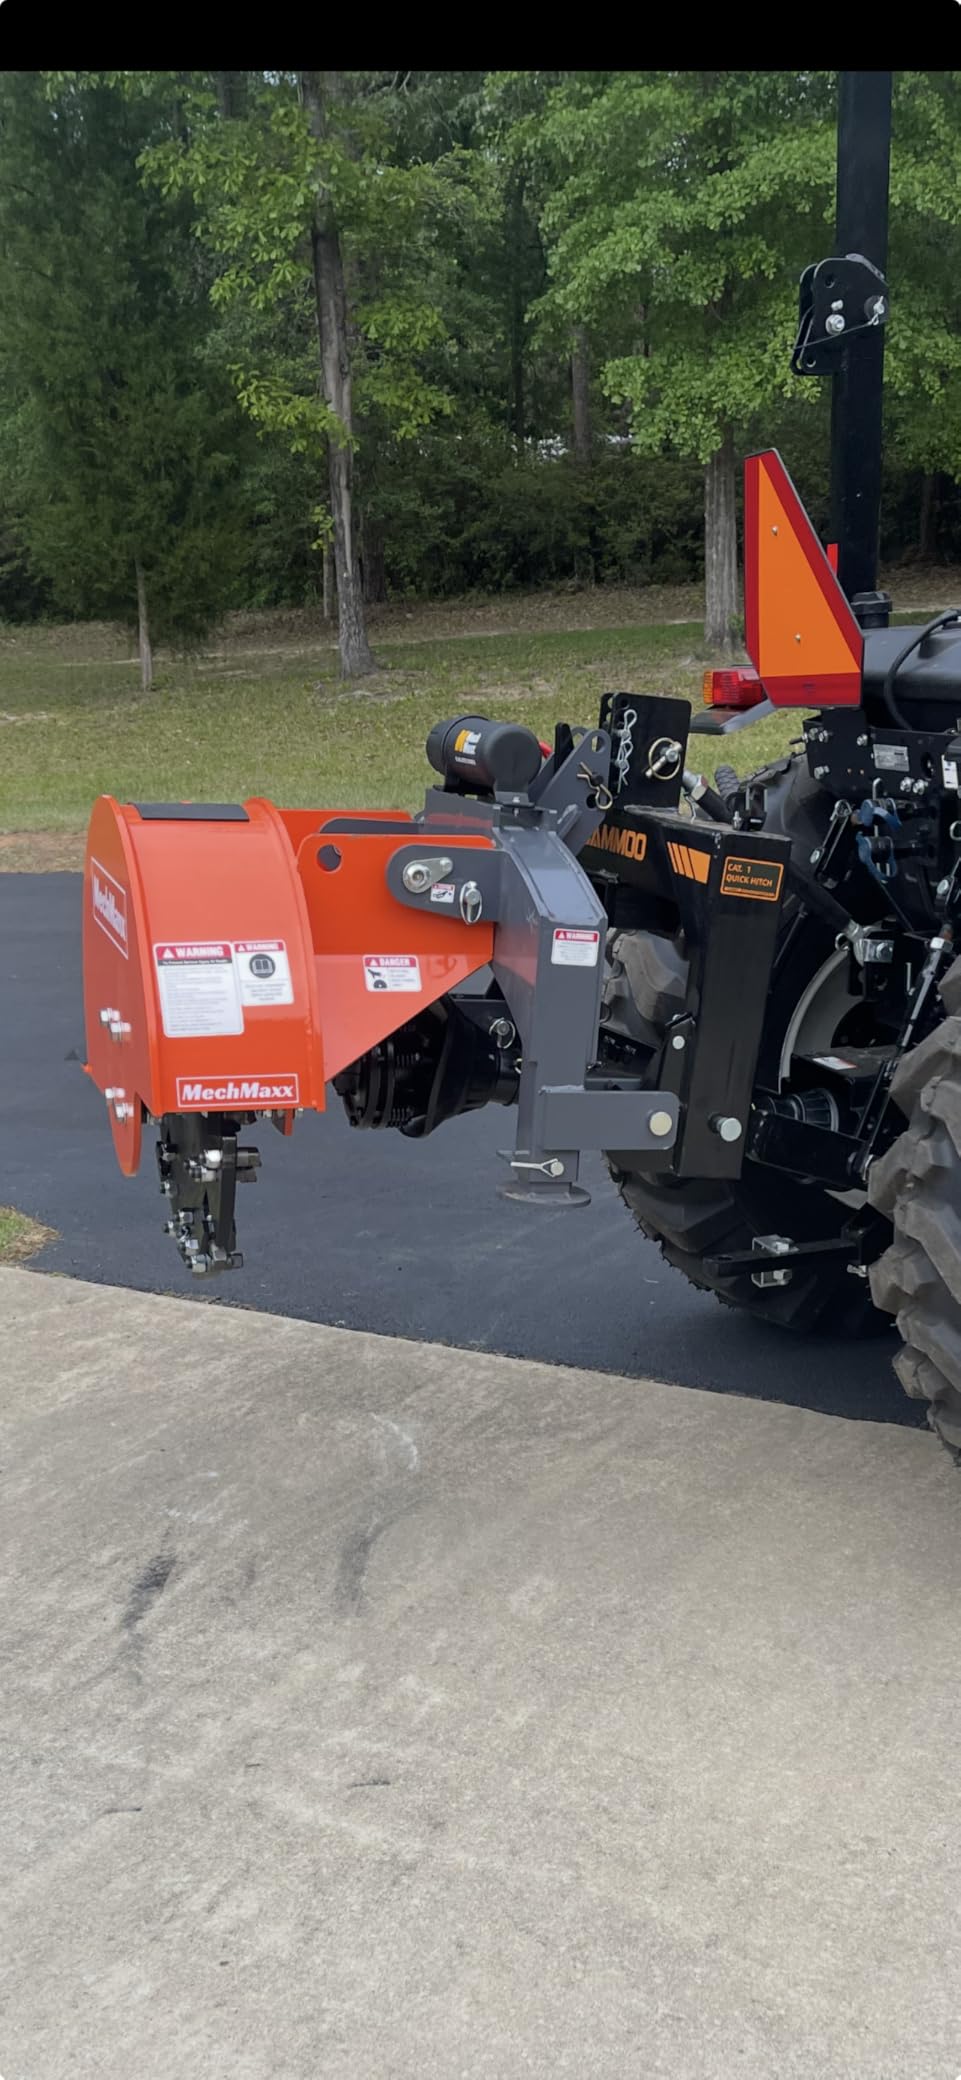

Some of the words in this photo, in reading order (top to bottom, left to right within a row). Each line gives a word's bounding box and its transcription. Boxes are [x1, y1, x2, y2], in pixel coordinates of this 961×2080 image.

[747, 866, 752, 874] 1
[726, 873, 750, 884] QUICK
[750, 877, 773, 888] HITCH
[175, 945, 225, 959] WARNING
[247, 942, 279, 952] WARNING
[379, 957, 410, 967] DANGER
[182, 1082, 294, 1101] MechMaxx
